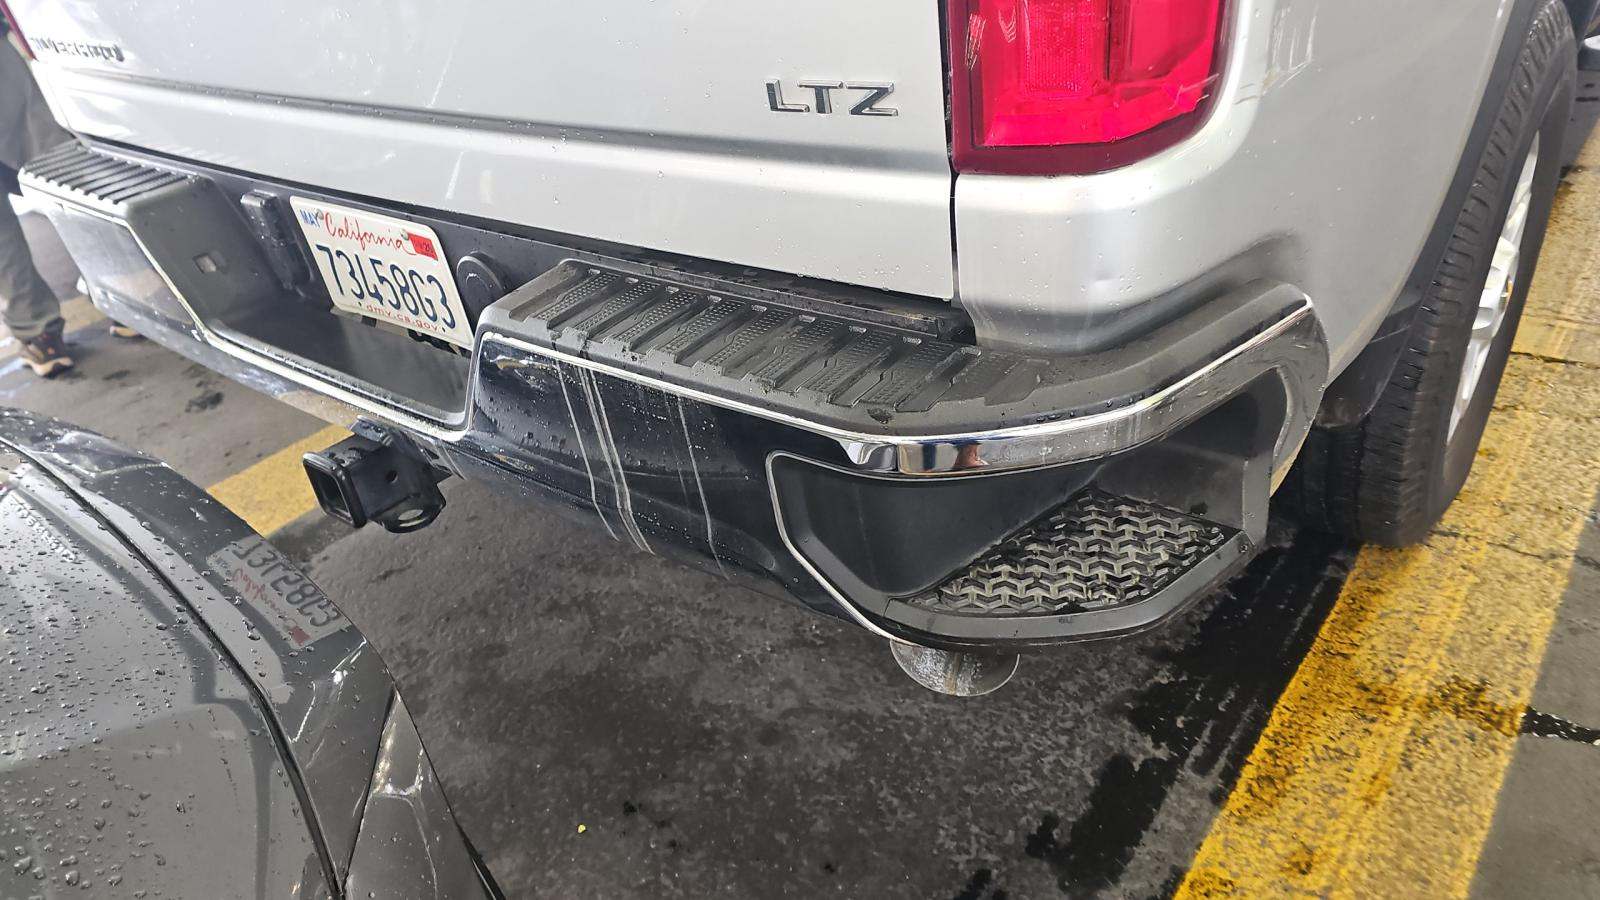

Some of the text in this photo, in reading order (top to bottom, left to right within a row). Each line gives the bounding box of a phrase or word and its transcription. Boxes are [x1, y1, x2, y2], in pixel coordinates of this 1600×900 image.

[764, 80, 898, 116] LTZ
[299, 208, 321, 228] MAY
[324, 210, 417, 256] California
[315, 243, 456, 329] 73458G3
[366, 303, 439, 333] dmv.ca.gov
